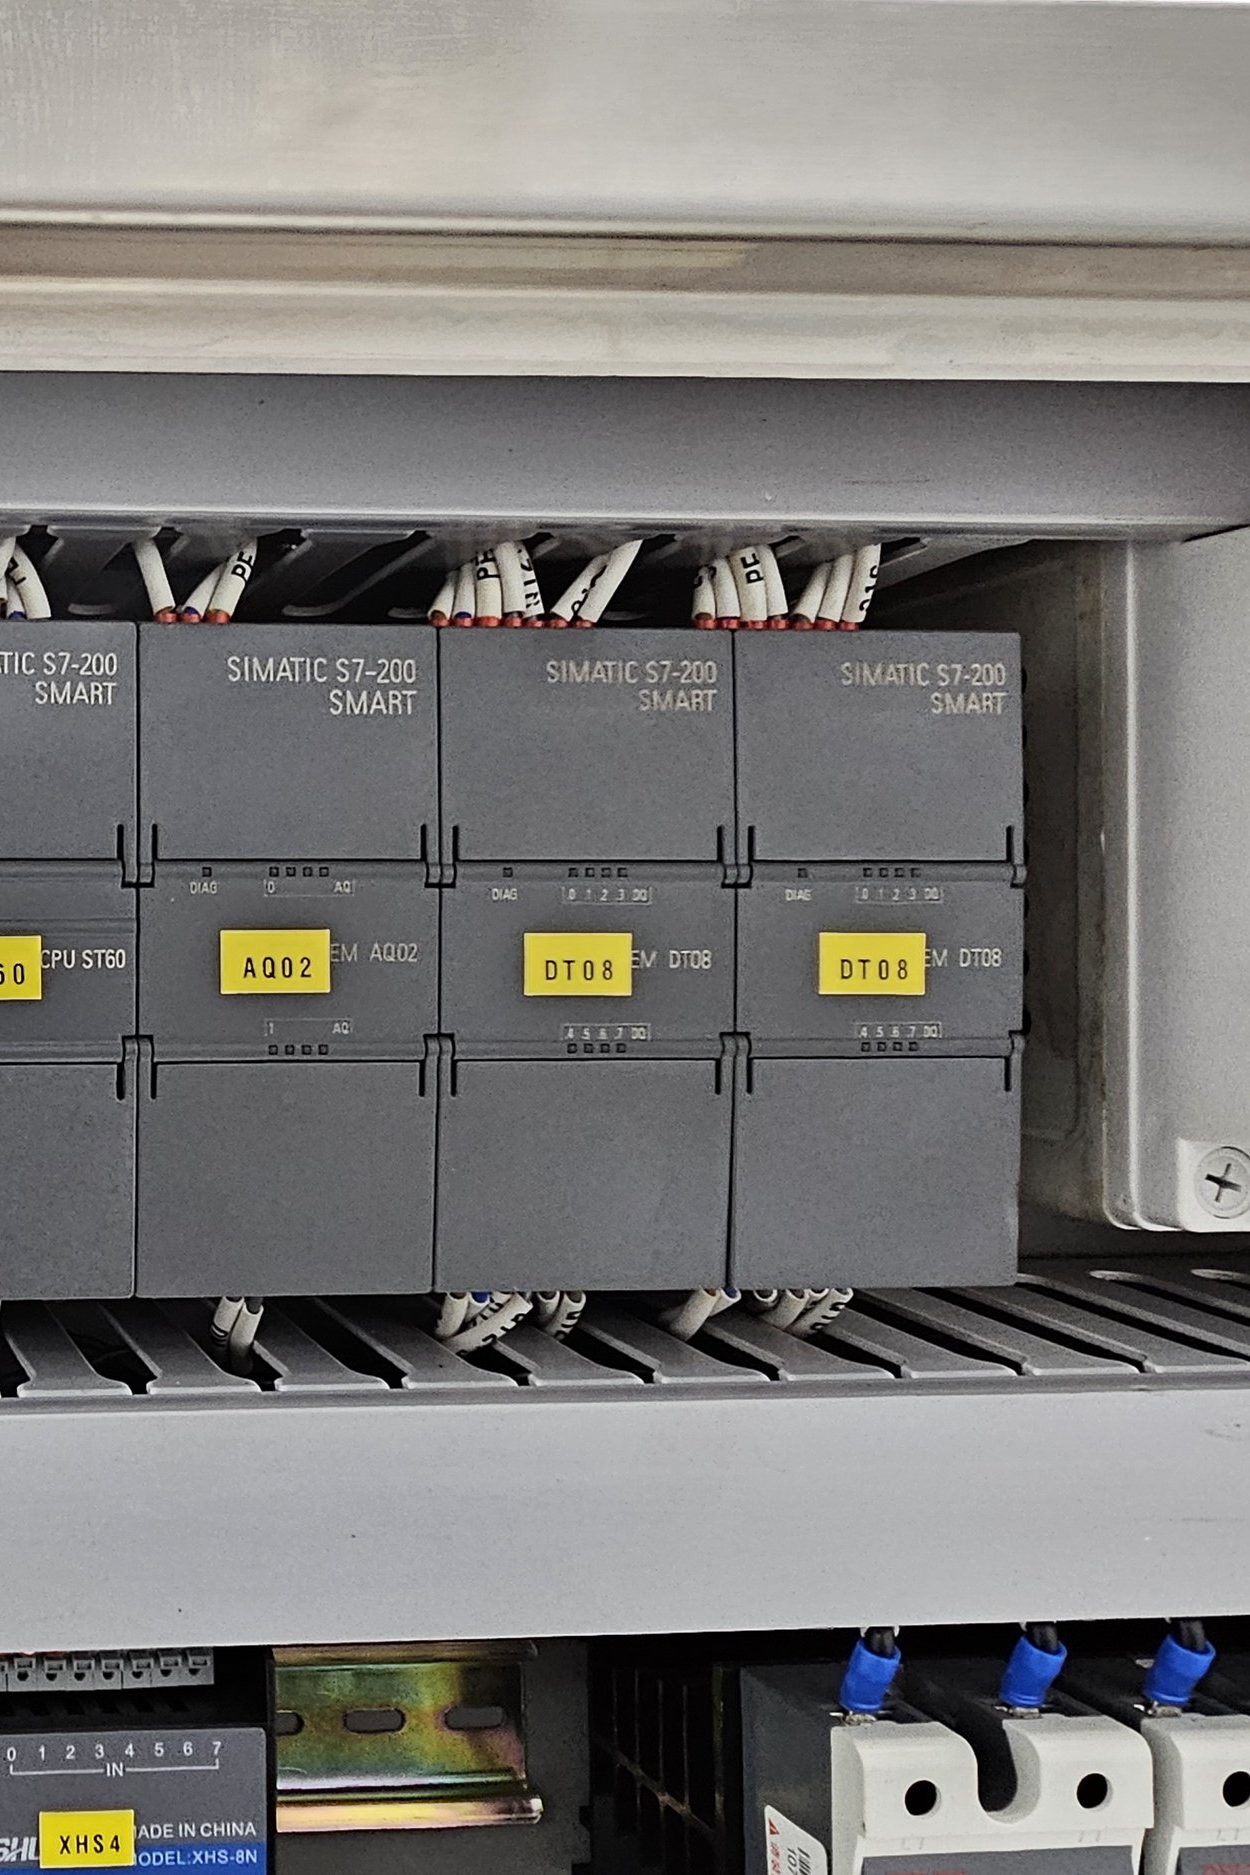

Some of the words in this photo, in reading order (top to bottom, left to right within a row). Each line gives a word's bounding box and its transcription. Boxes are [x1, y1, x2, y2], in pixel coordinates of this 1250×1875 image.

[44, 652, 117, 675] S7-200
[228, 656, 327, 682] SIMATIC
[336, 659, 415, 683] S7-200
[547, 661, 638, 683] SIMATIC
[646, 660, 716, 683] S7-200
[842, 663, 929, 686] SIMATIC
[937, 663, 1005, 686] S7-200
[36, 682, 116, 704] SMART
[330, 690, 417, 714] SMART
[640, 690, 717, 710] SMART
[931, 692, 1006, 714] SMART
[190, 881, 217, 894] DIAG
[335, 881, 350, 892] AQ
[492, 888, 517, 900] DIAG
[41, 949, 76, 969] CPU
[83, 949, 125, 968] ST60
[330, 944, 358, 963] EM
[370, 943, 417, 962] AQ02
[670, 950, 711, 968] DT08
[960, 948, 1001, 967] DT08
[244, 957, 311, 978] AQ02
[546, 960, 612, 980] DT08
[841, 959, 907, 980] DT08
[333, 1022, 349, 1034] AQ
[7, 1747, 16, 1761] 0
[39, 1746, 44, 1760] 1
[66, 1745, 75, 1759] 2
[95, 1744, 104, 1758] 3
[125, 1743, 134, 1757] 4
[155, 1742, 164, 1756] 5
[183, 1742, 192, 1756] 6
[213, 1741, 221, 1755] 7
[107, 1763, 123, 1776] IN
[135, 1825, 173, 1839] ADE
[179, 1824, 196, 1838] IN
[201, 1822, 256, 1837] CHINA
[60, 1834, 119, 1854] XHS4
[134, 1850, 257, 1866] ODEL:XHS-8N
